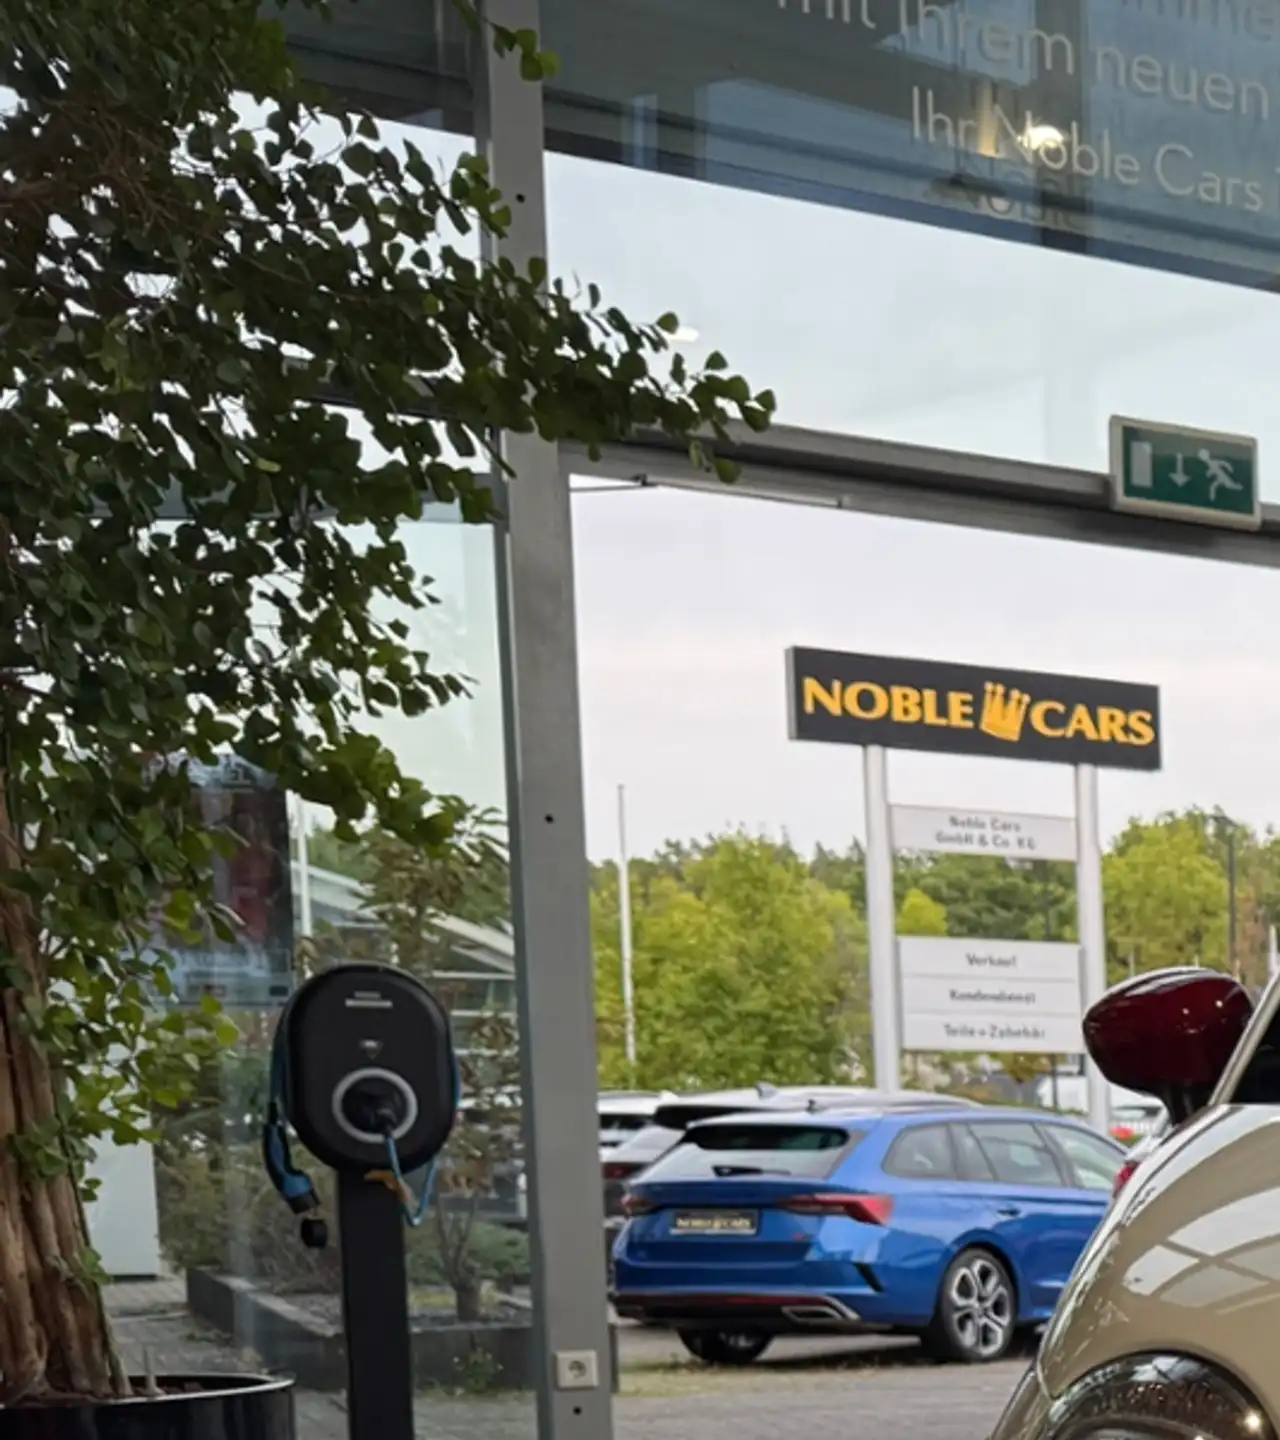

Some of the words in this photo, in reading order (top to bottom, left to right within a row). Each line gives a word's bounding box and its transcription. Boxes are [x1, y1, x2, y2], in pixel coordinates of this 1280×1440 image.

[1096, 45, 1269, 119] neuen
[911, 86, 975, 147] Ihr
[993, 103, 1141, 186] Noble
[1154, 143, 1264, 213] Cars
[803, 677, 975, 729] NOBLE
[1030, 701, 1155, 745] CARS
